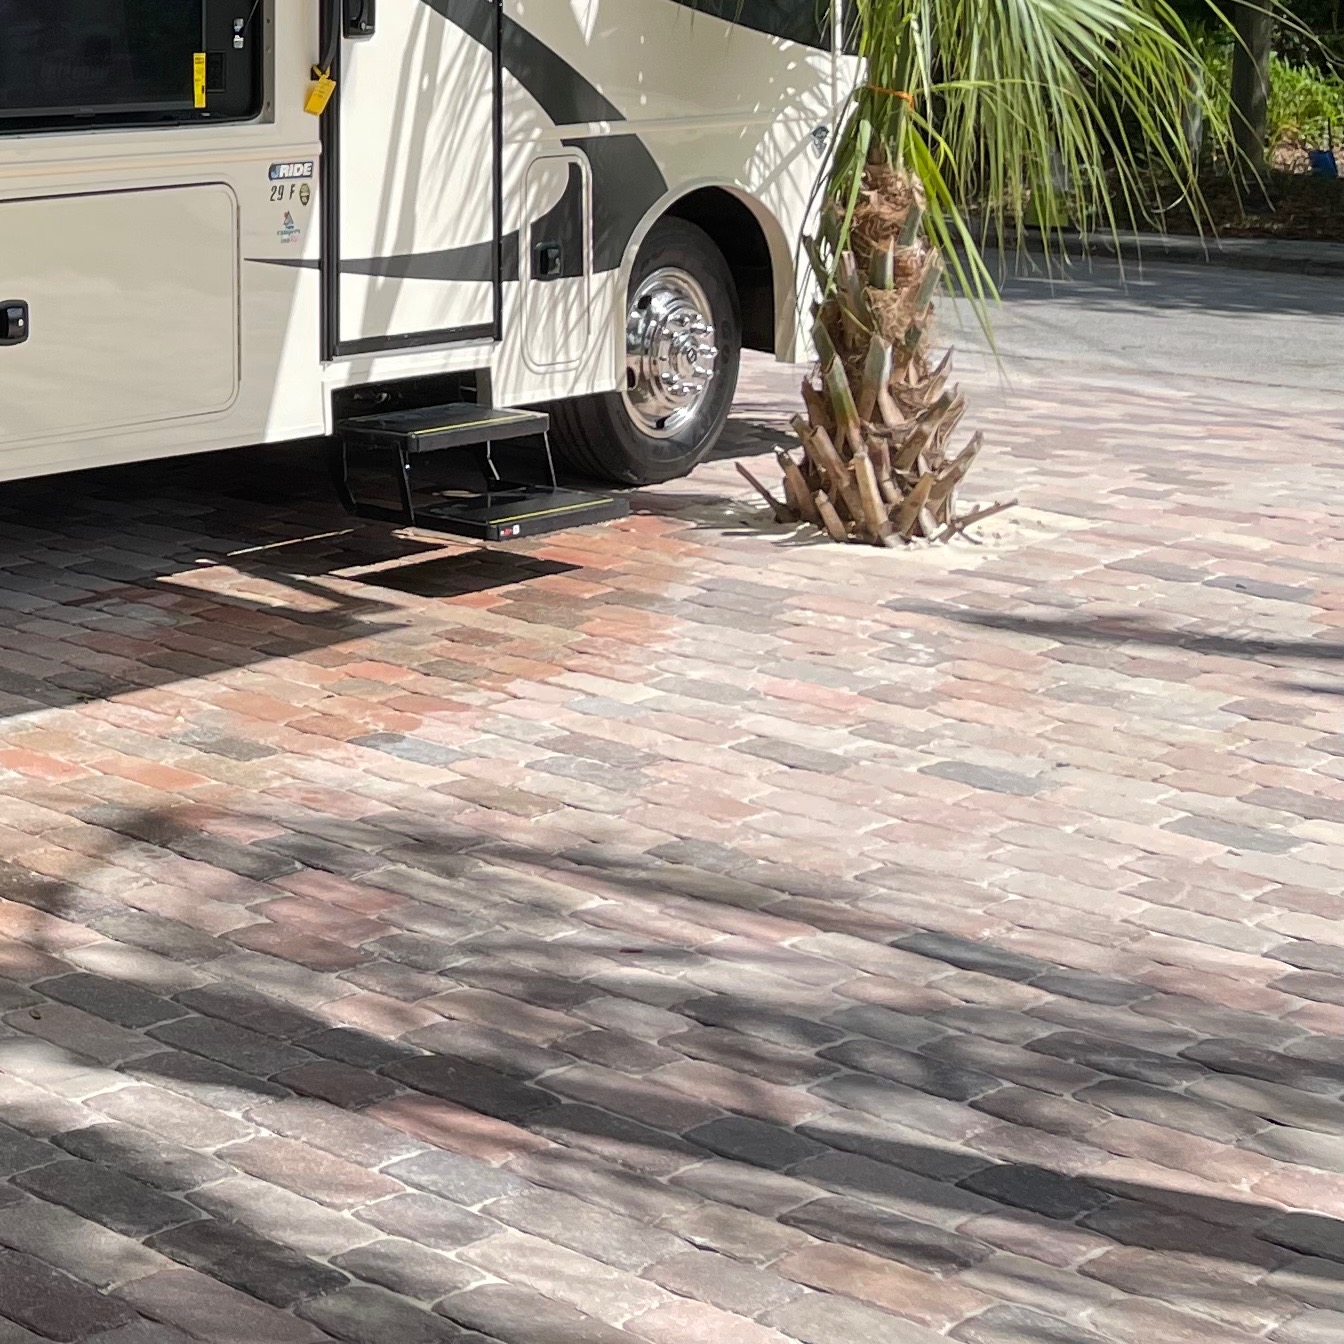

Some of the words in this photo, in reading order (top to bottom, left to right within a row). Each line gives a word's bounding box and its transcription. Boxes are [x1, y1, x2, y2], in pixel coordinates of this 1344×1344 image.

[270, 162, 313, 179] JRIDE
[269, 184, 285, 202] 29
[289, 183, 296, 201] F
